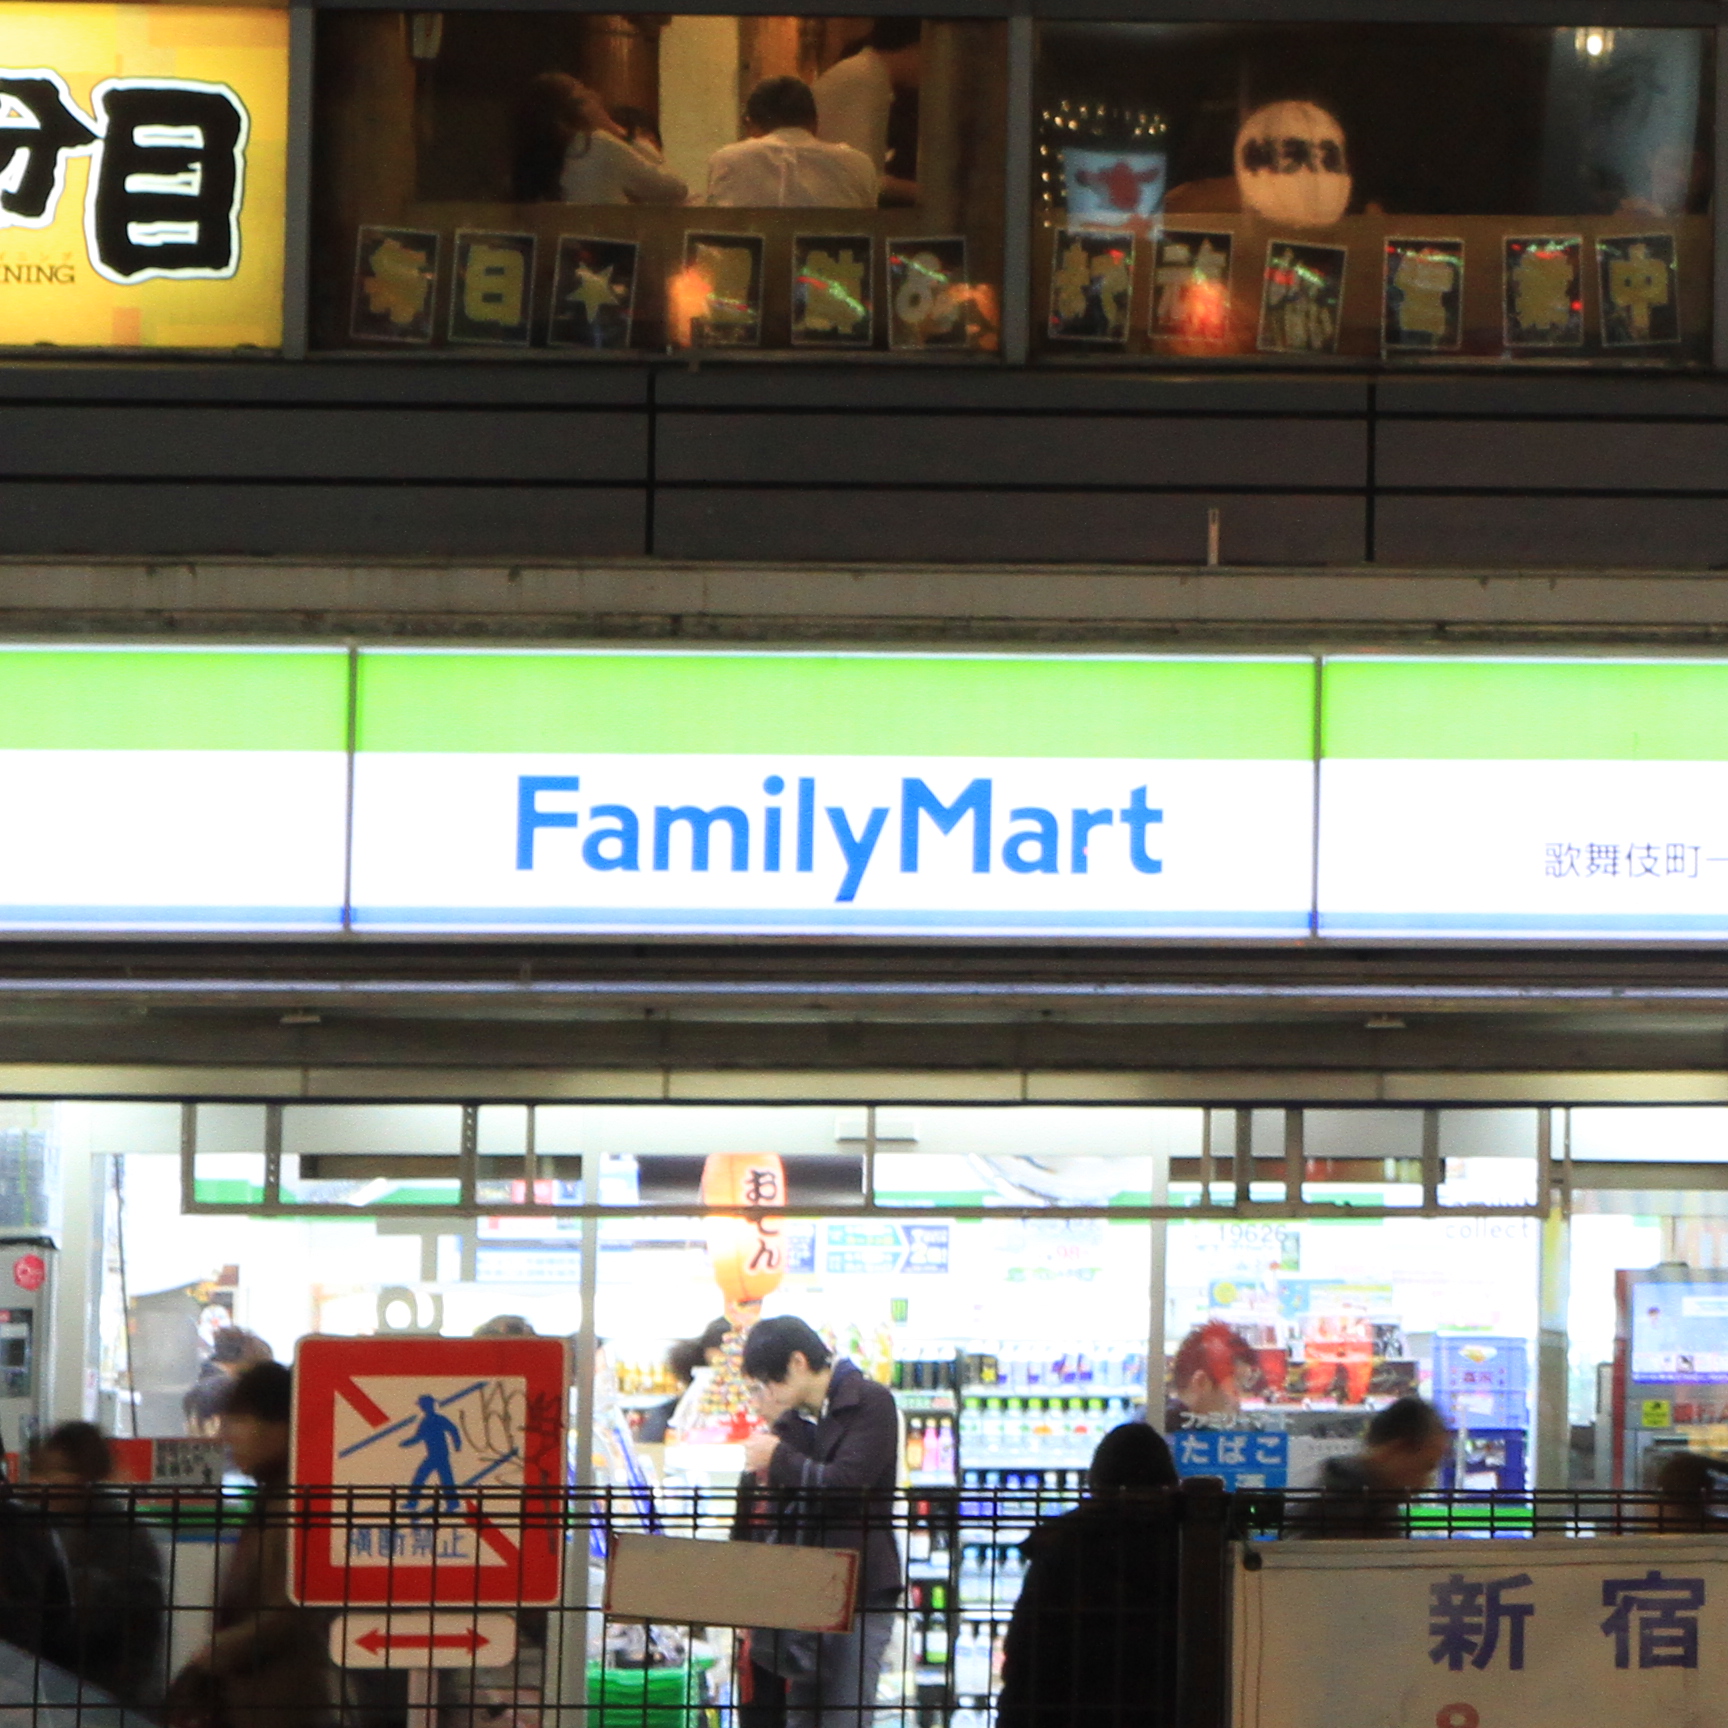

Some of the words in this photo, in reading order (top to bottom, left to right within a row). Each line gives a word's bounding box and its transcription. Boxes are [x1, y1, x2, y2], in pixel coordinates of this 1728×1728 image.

[516, 774, 1164, 903] FamilyMart
[1181, 1434, 1284, 1466] たばこ
